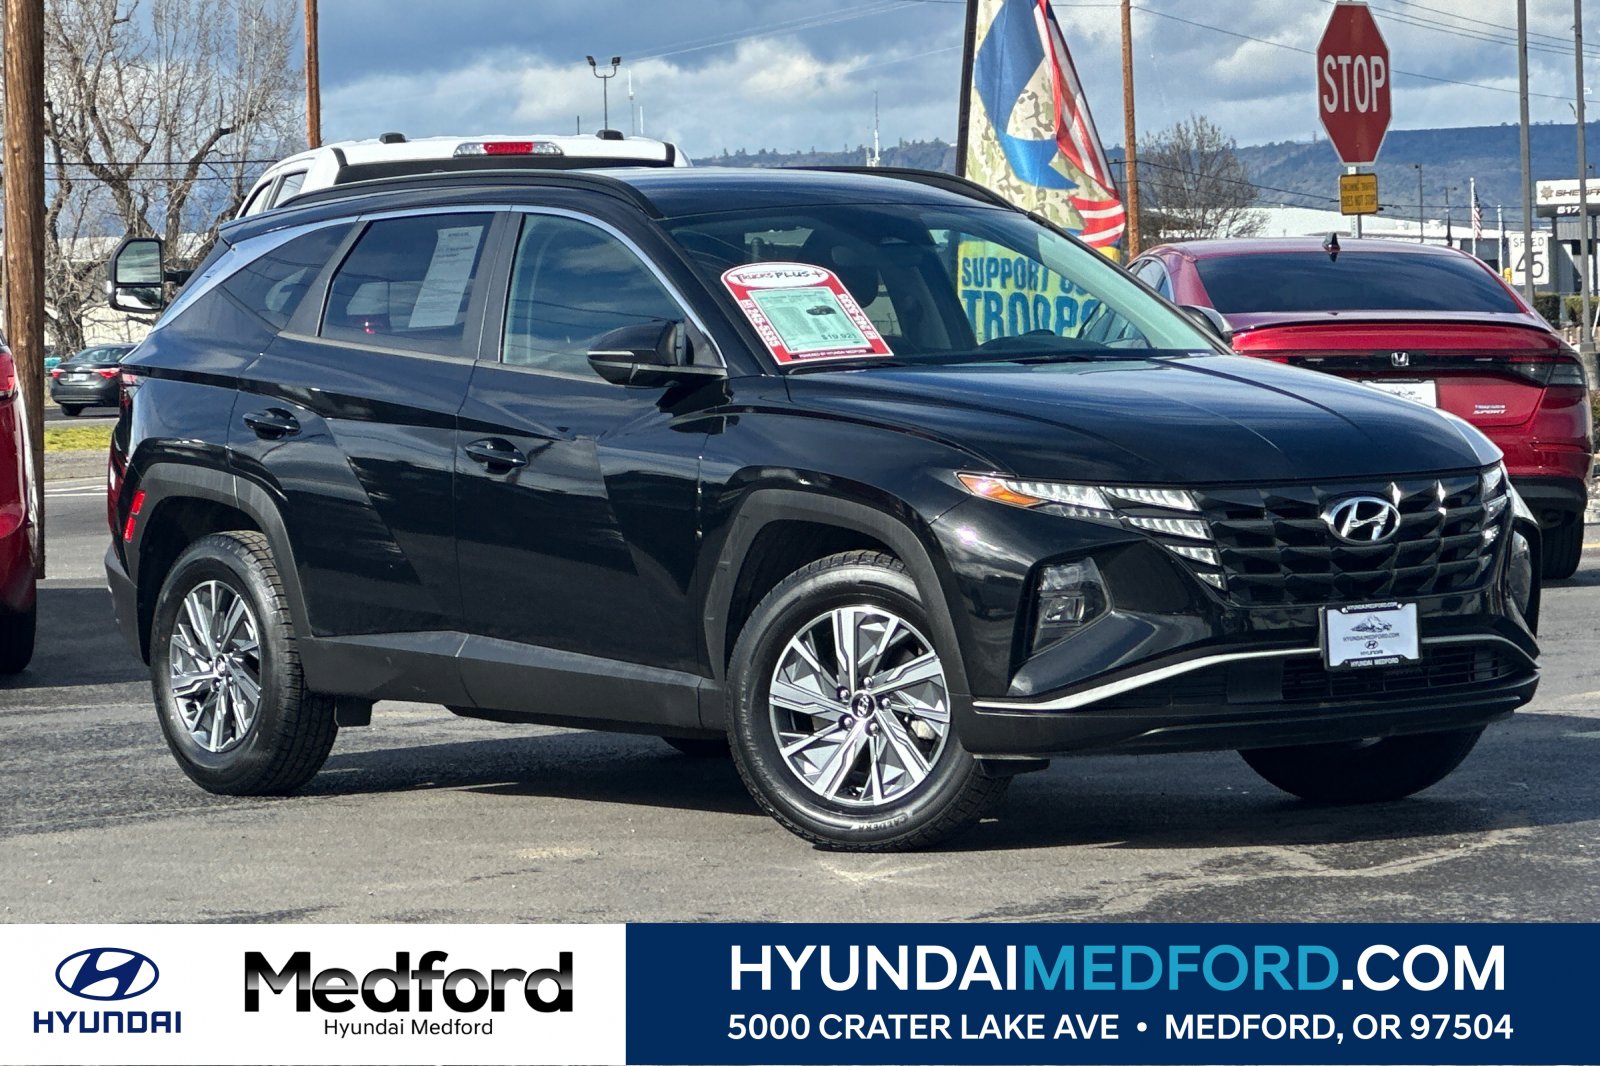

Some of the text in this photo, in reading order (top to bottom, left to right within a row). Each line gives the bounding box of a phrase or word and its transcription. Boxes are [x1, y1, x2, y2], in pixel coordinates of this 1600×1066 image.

[1323, 55, 1386, 113] STOP
[1555, 189, 1600, 197] SHEIFF
[1556, 206, 1581, 214] 517
[1513, 236, 1545, 247] SPED
[1515, 251, 1544, 278] 45
[962, 257, 1049, 292] SUPPORT
